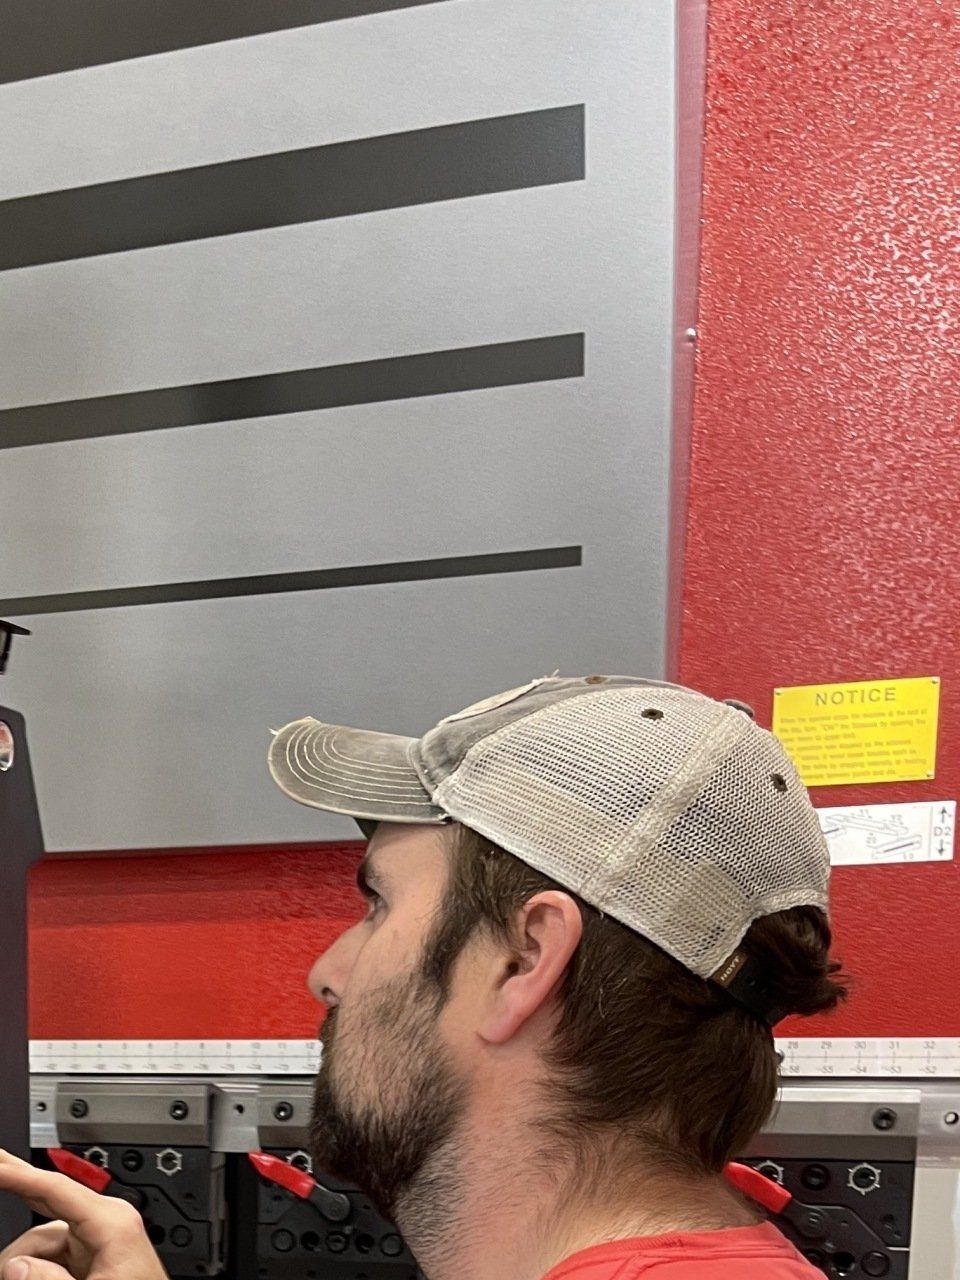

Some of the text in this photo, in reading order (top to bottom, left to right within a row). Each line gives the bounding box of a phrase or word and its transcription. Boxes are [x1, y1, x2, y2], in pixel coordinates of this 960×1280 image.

[815, 687, 897, 707] NOTICE
[934, 826, 952, 837] D2
[720, 955, 740, 981] HOYT
[820, 1041, 832, 1050] 29
[854, 1041, 867, 1050] 30
[888, 1041, 900, 1050] 31
[923, 1041, 937, 1050] 32
